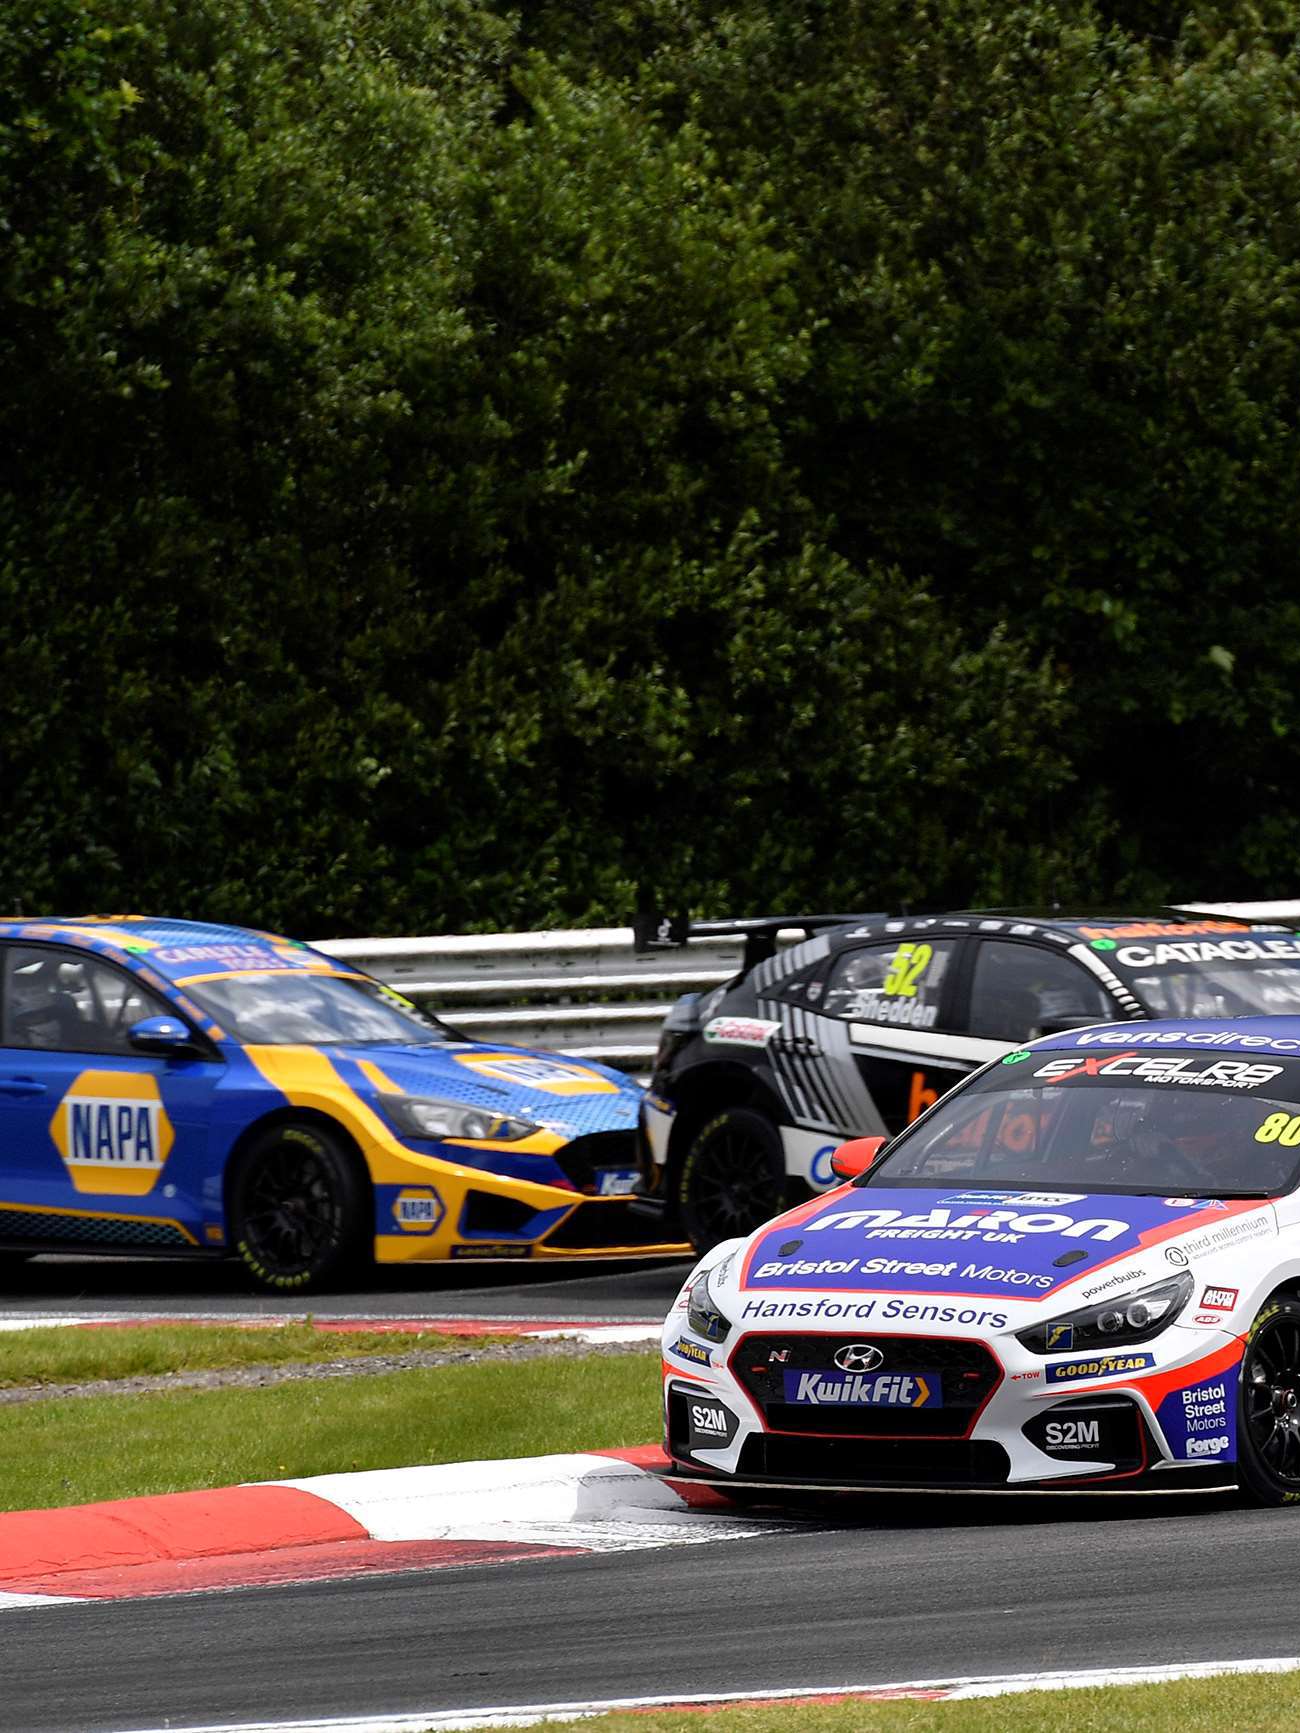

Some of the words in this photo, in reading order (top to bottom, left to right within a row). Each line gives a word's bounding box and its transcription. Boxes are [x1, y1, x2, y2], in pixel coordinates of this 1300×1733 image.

[884, 943, 932, 997] 52
[1033, 1052, 1284, 1085] EXCELR8
[1143, 1075, 1260, 1090] MOTORSPORT
[72, 1103, 154, 1162] NAPA
[865, 1230, 981, 1242] FREIGHT
[985, 1231, 1026, 1244] UK
[1184, 1235, 1212, 1255] third
[1212, 1216, 1269, 1242] millennium
[754, 1259, 858, 1279] Bristol
[860, 1257, 959, 1278] Street
[959, 1263, 1056, 1289] Motors
[1081, 1268, 1147, 1300] powerbulbs
[741, 1299, 877, 1320] Hansford
[881, 1300, 1009, 1329] Sensors
[1023, 1372, 1040, 1380] TOW
[1055, 1356, 1146, 1377] GOODYEAR
[1182, 1384, 1226, 1405] Bristol
[692, 1405, 728, 1432] S2M
[1184, 1401, 1226, 1419] Street
[1045, 1421, 1100, 1444] S2M
[1186, 1417, 1227, 1432] Motors
